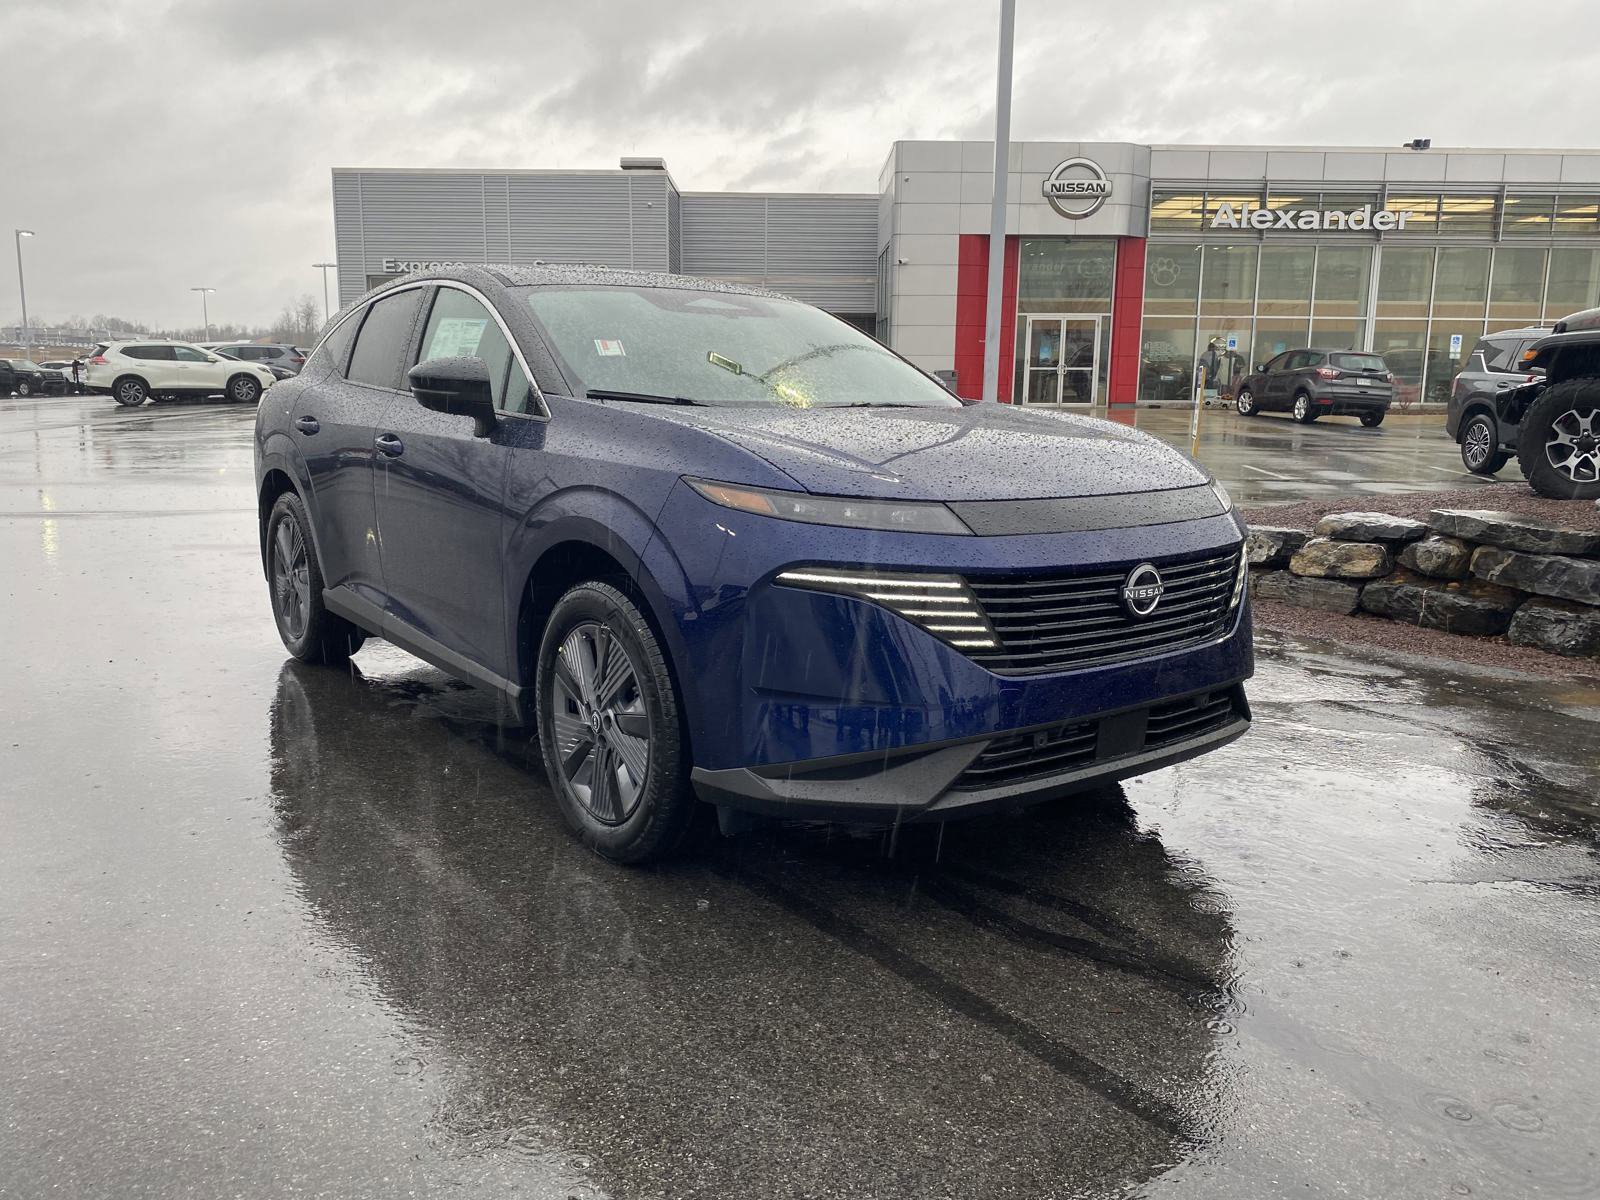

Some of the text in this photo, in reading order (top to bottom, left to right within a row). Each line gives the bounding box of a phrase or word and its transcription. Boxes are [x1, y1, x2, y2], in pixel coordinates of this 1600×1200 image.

[1050, 183, 1106, 193] NISSAN
[1210, 203, 1414, 231] Alexander
[1125, 587, 1164, 598] NISSAN
